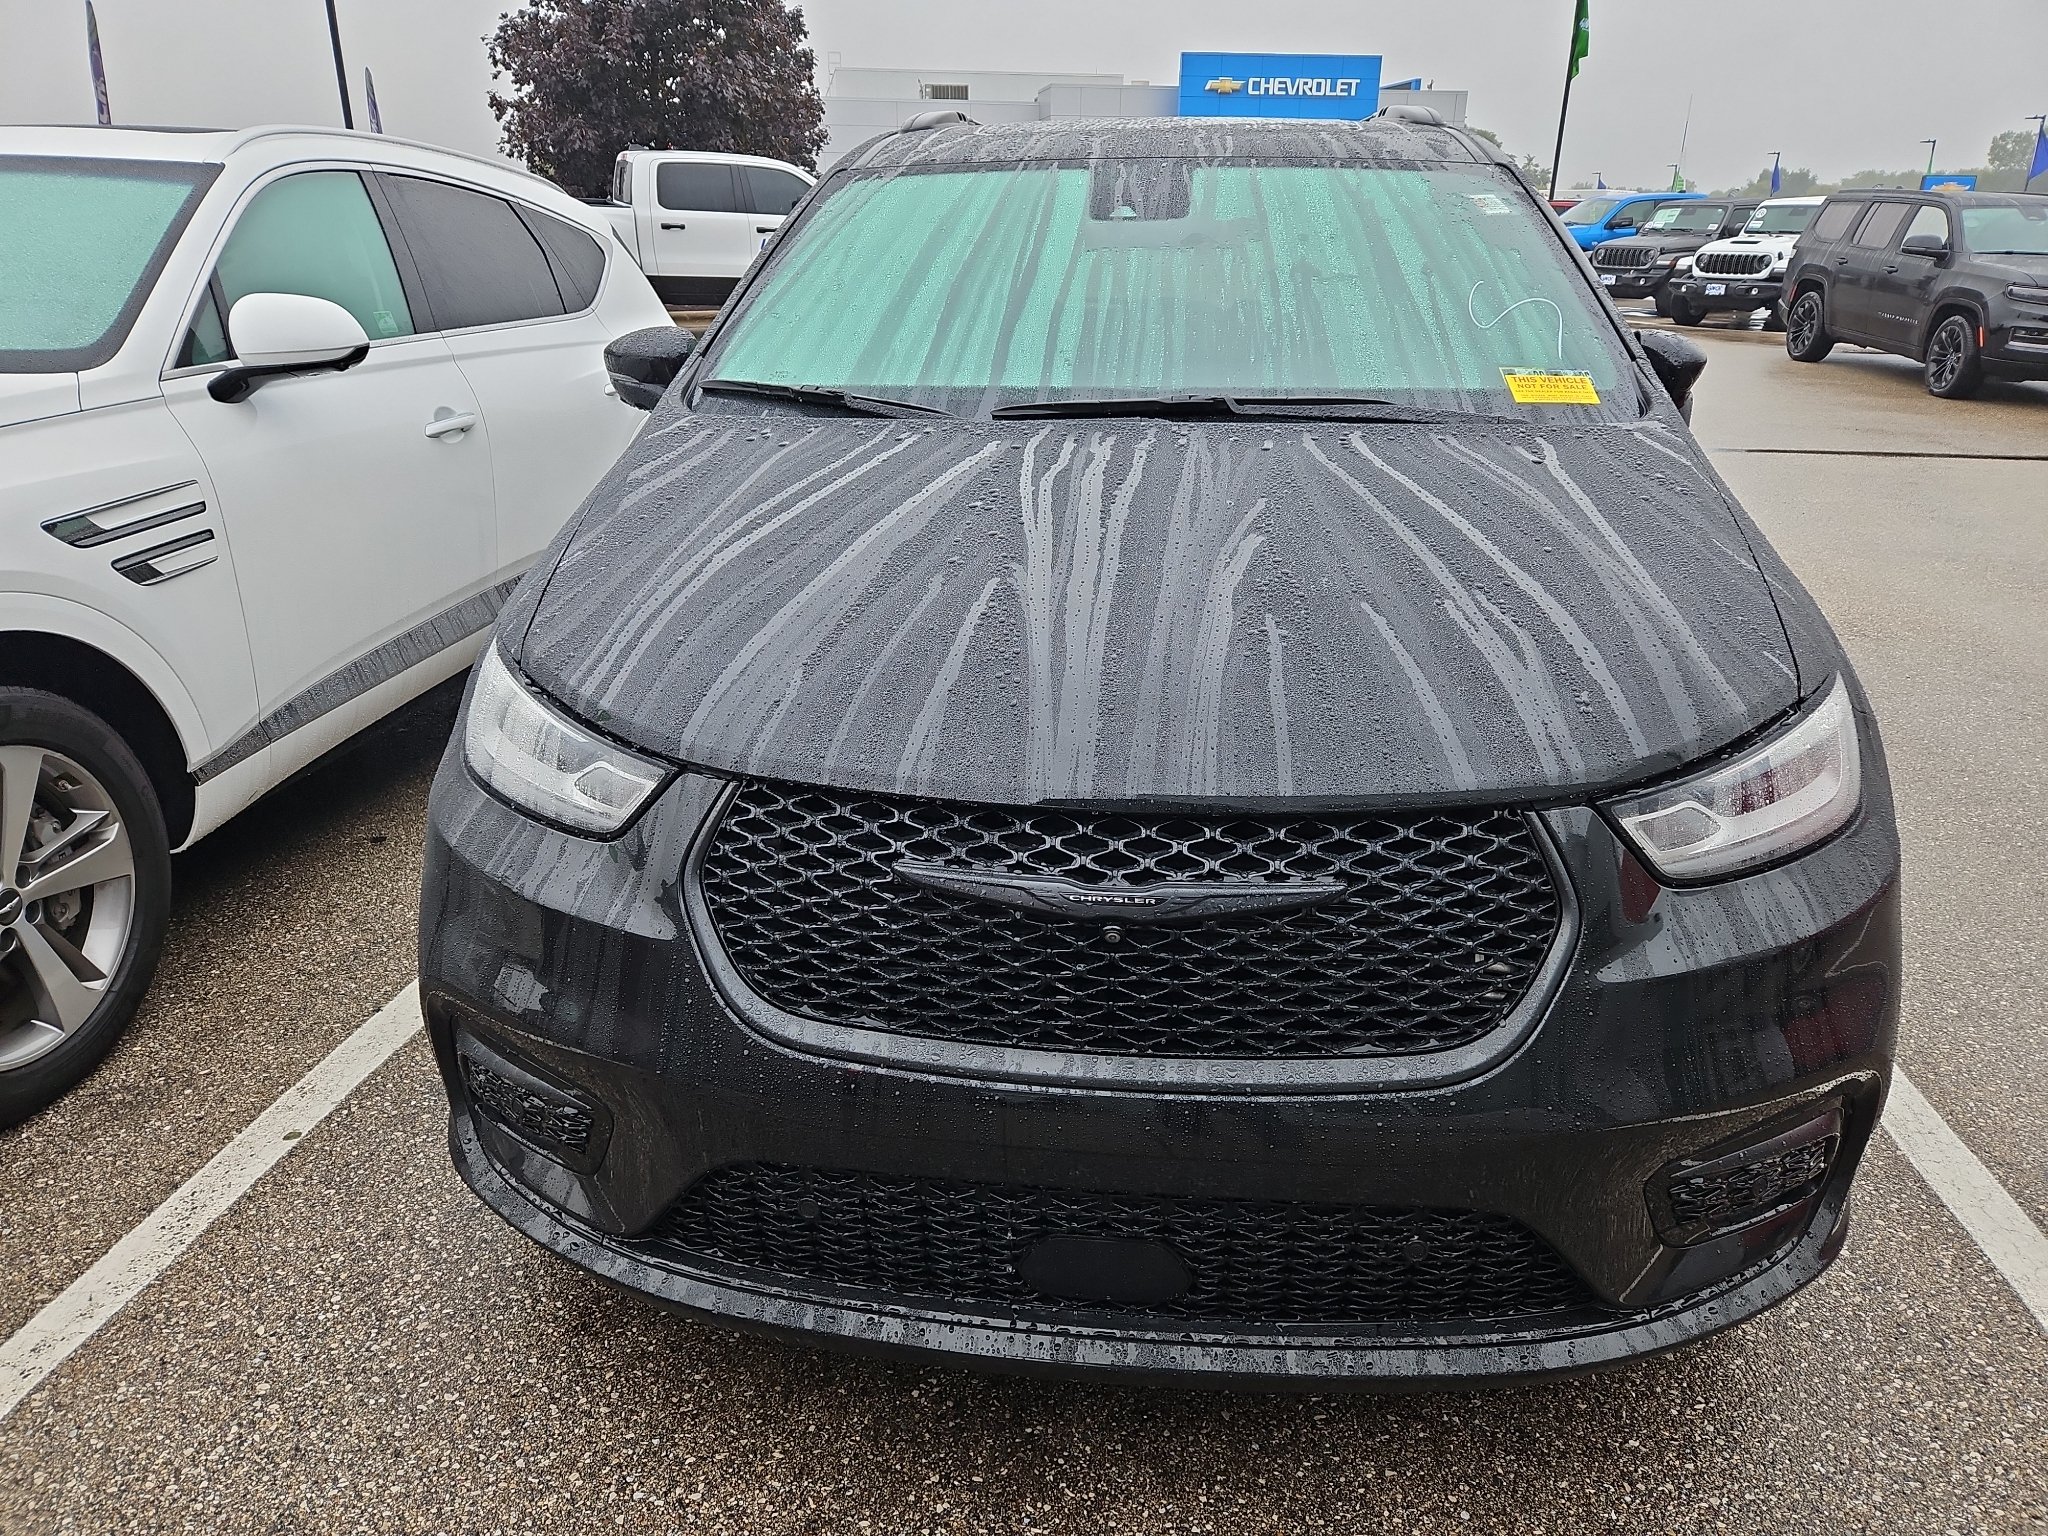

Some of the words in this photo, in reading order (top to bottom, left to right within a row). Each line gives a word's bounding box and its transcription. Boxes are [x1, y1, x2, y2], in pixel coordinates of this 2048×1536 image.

[1247, 77, 1361, 97] CHEVROLET
[1539, 376, 1588, 384] VEHICLE
[1069, 895, 1156, 905] CHRYSLER
